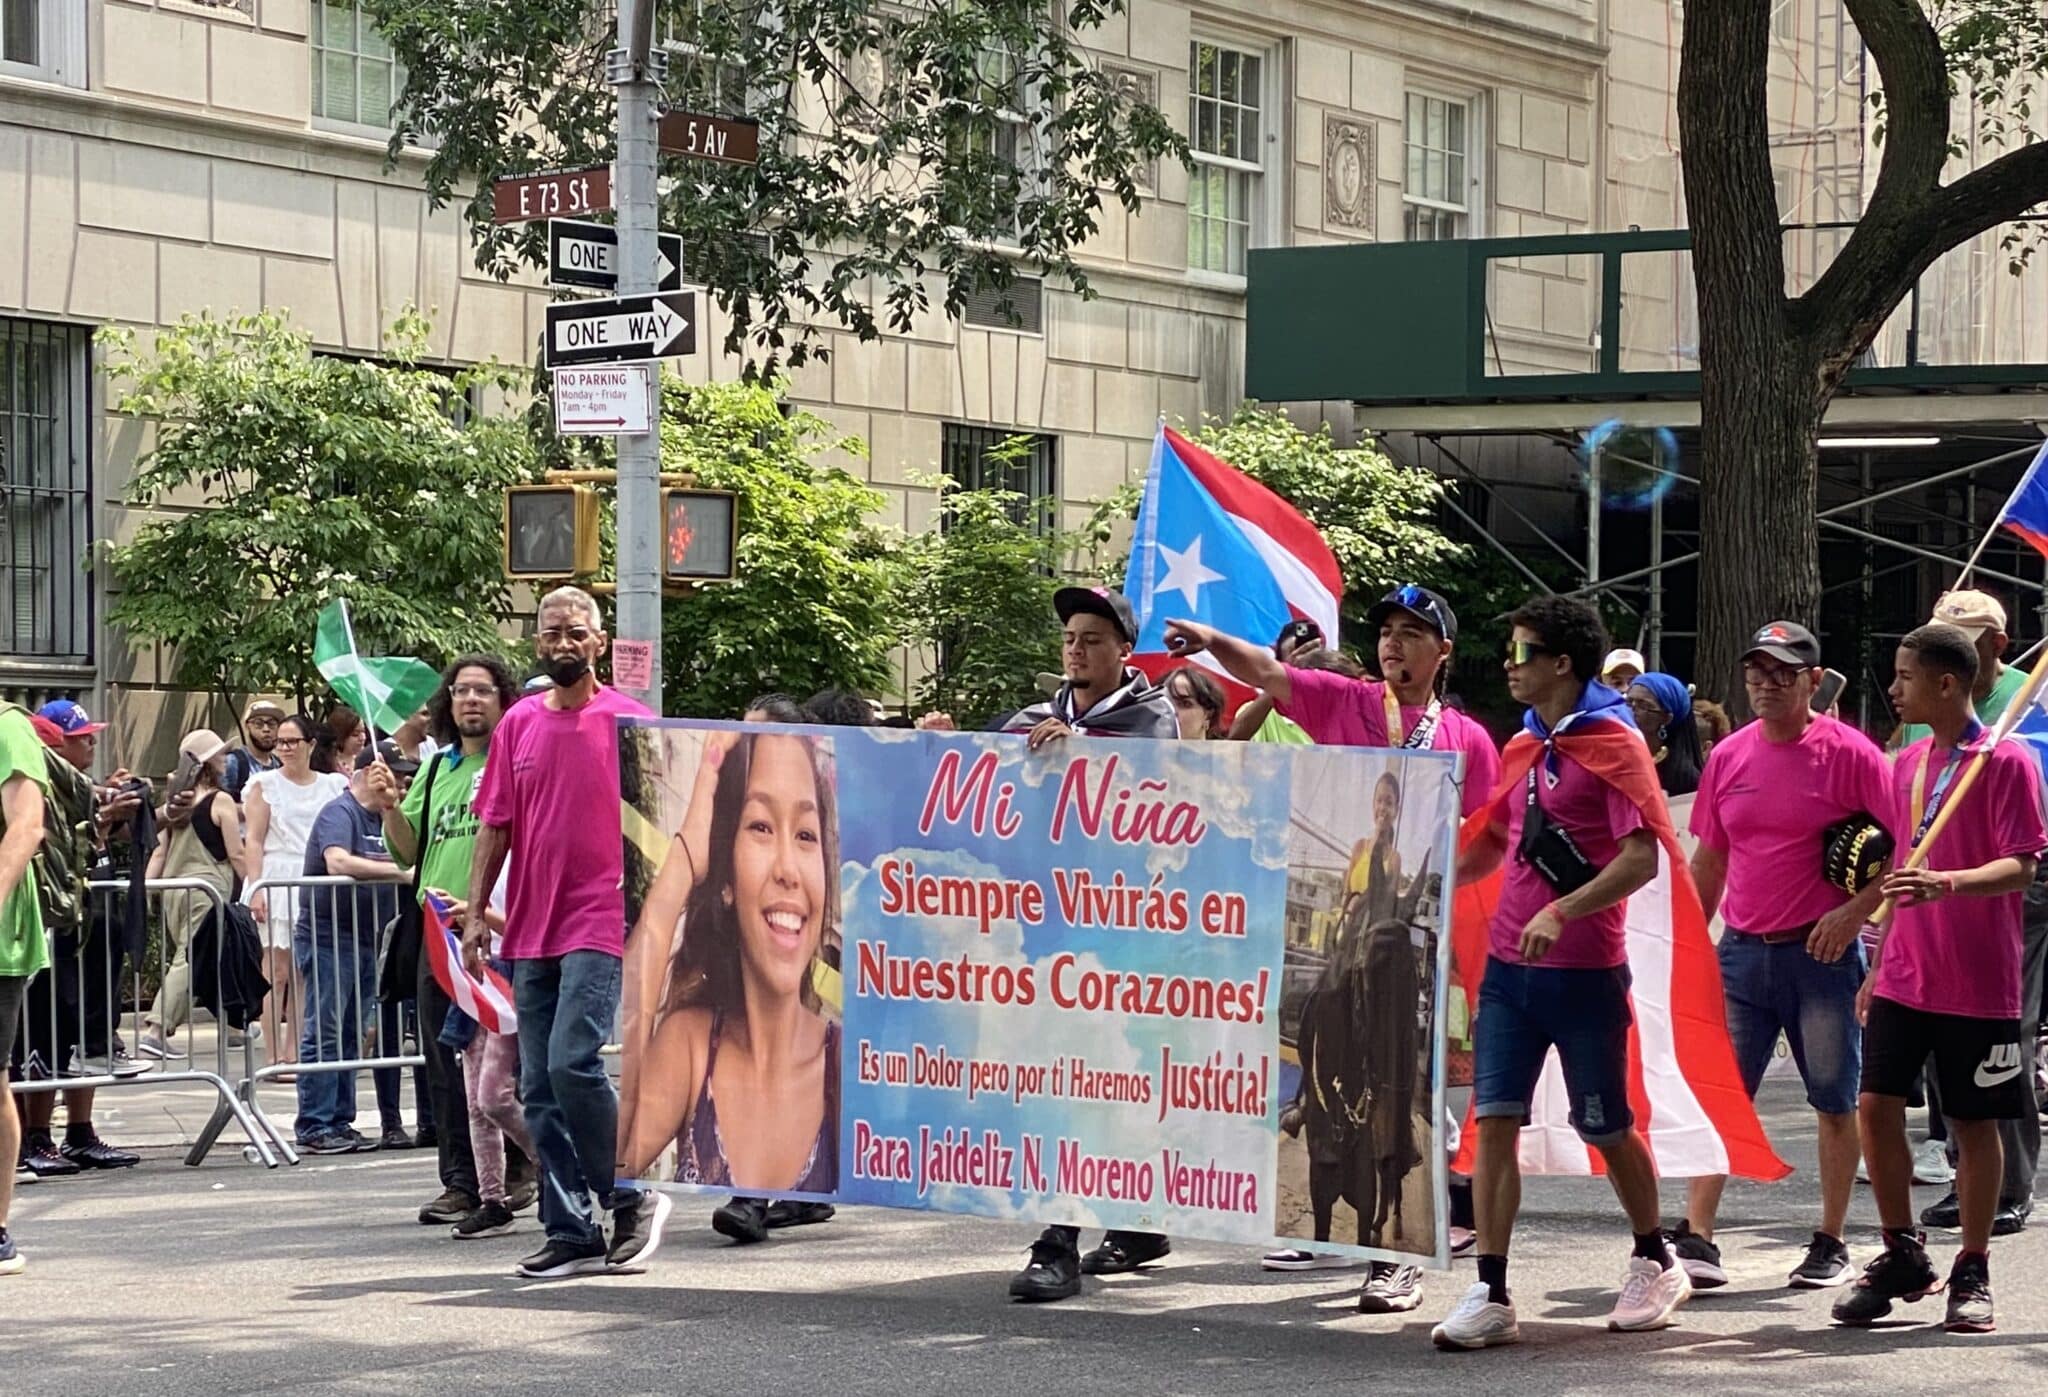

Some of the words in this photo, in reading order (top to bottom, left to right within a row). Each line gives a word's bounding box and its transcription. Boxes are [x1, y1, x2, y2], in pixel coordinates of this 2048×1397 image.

[687, 121, 697, 152] 5
[703, 124, 728, 156] Av
[520, 185, 531, 216] E
[538, 182, 560, 214] 73
[569, 177, 589, 210] St
[569, 243, 608, 271] ONE
[567, 320, 608, 347] ONE
[628, 313, 672, 342] WAY
[560, 374, 576, 386] NO
[580, 373, 627, 386] PARKING
[561, 390, 593, 400] Monday
[601, 388, 627, 400] Friday
[562, 402, 580, 412] 7am
[588, 402, 607, 412] 4pm
[919, 750, 1022, 837] Mi
[1048, 753, 1207, 846] Niña
[880, 860, 1044, 933] Siempre
[1052, 869, 1189, 933] Vivirás
[1200, 891, 1247, 936] en
[857, 942, 1036, 1006] Nuestros
[1050, 954, 1269, 1024] Corazones!
[860, 1042, 880, 1082] Es
[886, 1055, 908, 1084] un
[914, 1046, 964, 1088] Dolor
[969, 1060, 1009, 1100] pero
[1015, 1063, 1046, 1104] por
[1051, 1056, 1065, 1097] ti
[1069, 1058, 1151, 1104] Haremos
[1158, 1046, 1269, 1124] Justicia!
[855, 1122, 911, 1180] Para
[918, 1127, 1013, 1196] Jaideliz
[1022, 1136, 1048, 1193] N.
[1056, 1139, 1154, 1203] Moreno
[1162, 1149, 1258, 1215] Ventura
